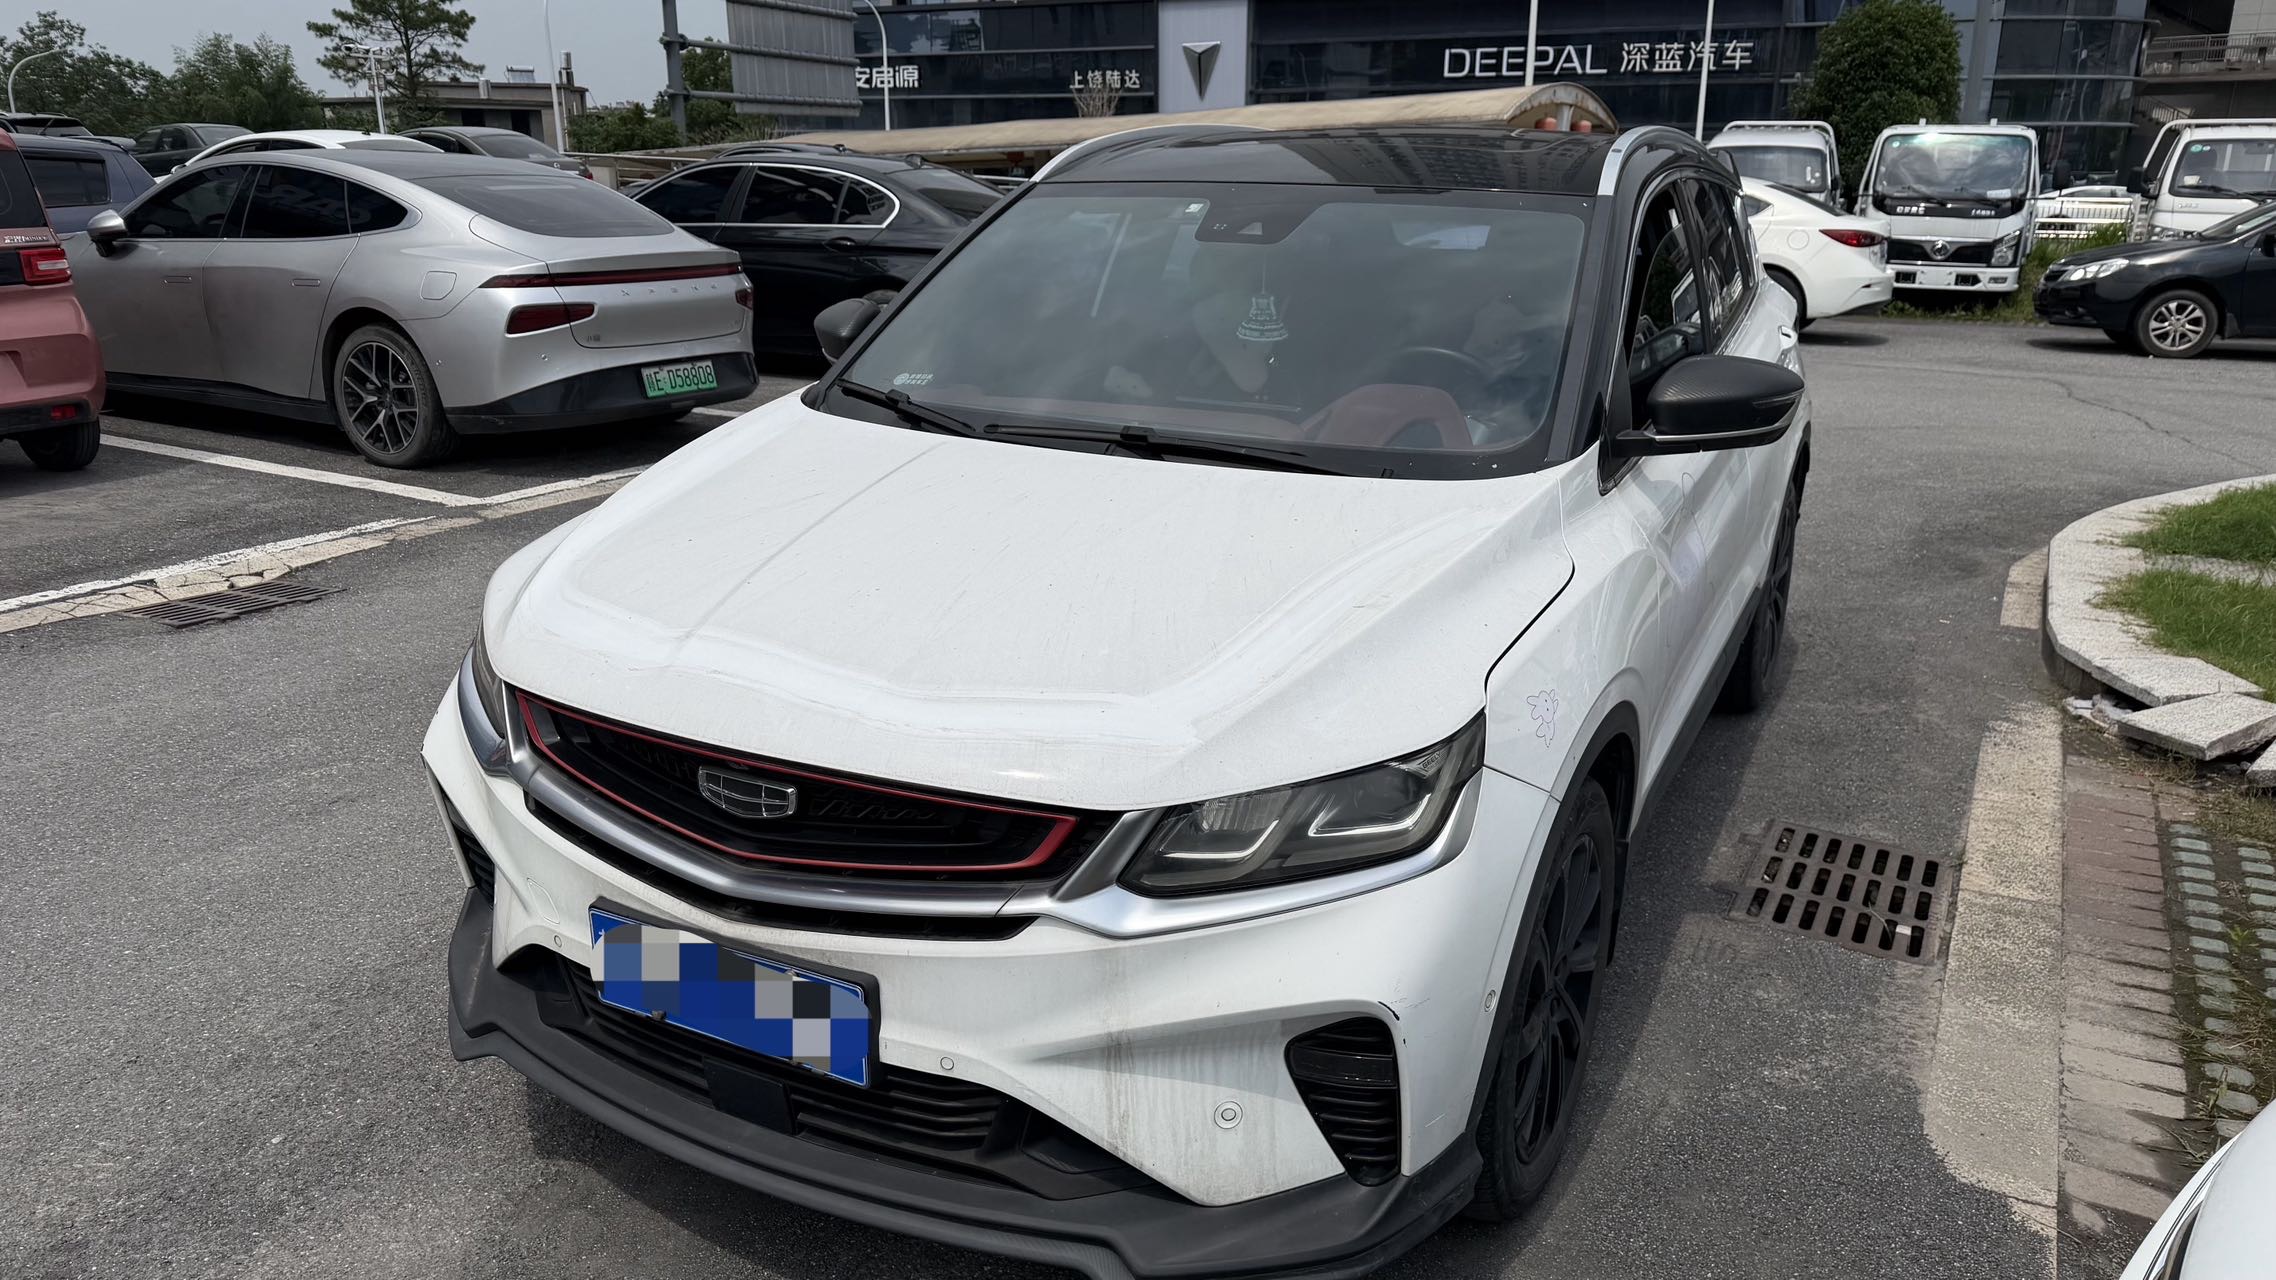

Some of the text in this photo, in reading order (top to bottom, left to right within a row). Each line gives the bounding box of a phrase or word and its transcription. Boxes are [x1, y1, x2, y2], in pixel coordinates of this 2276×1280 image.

[1443, 40, 1754, 77] DEEPAL 深蓝汽车
[1069, 69, 1141, 88] 上饶陆达
